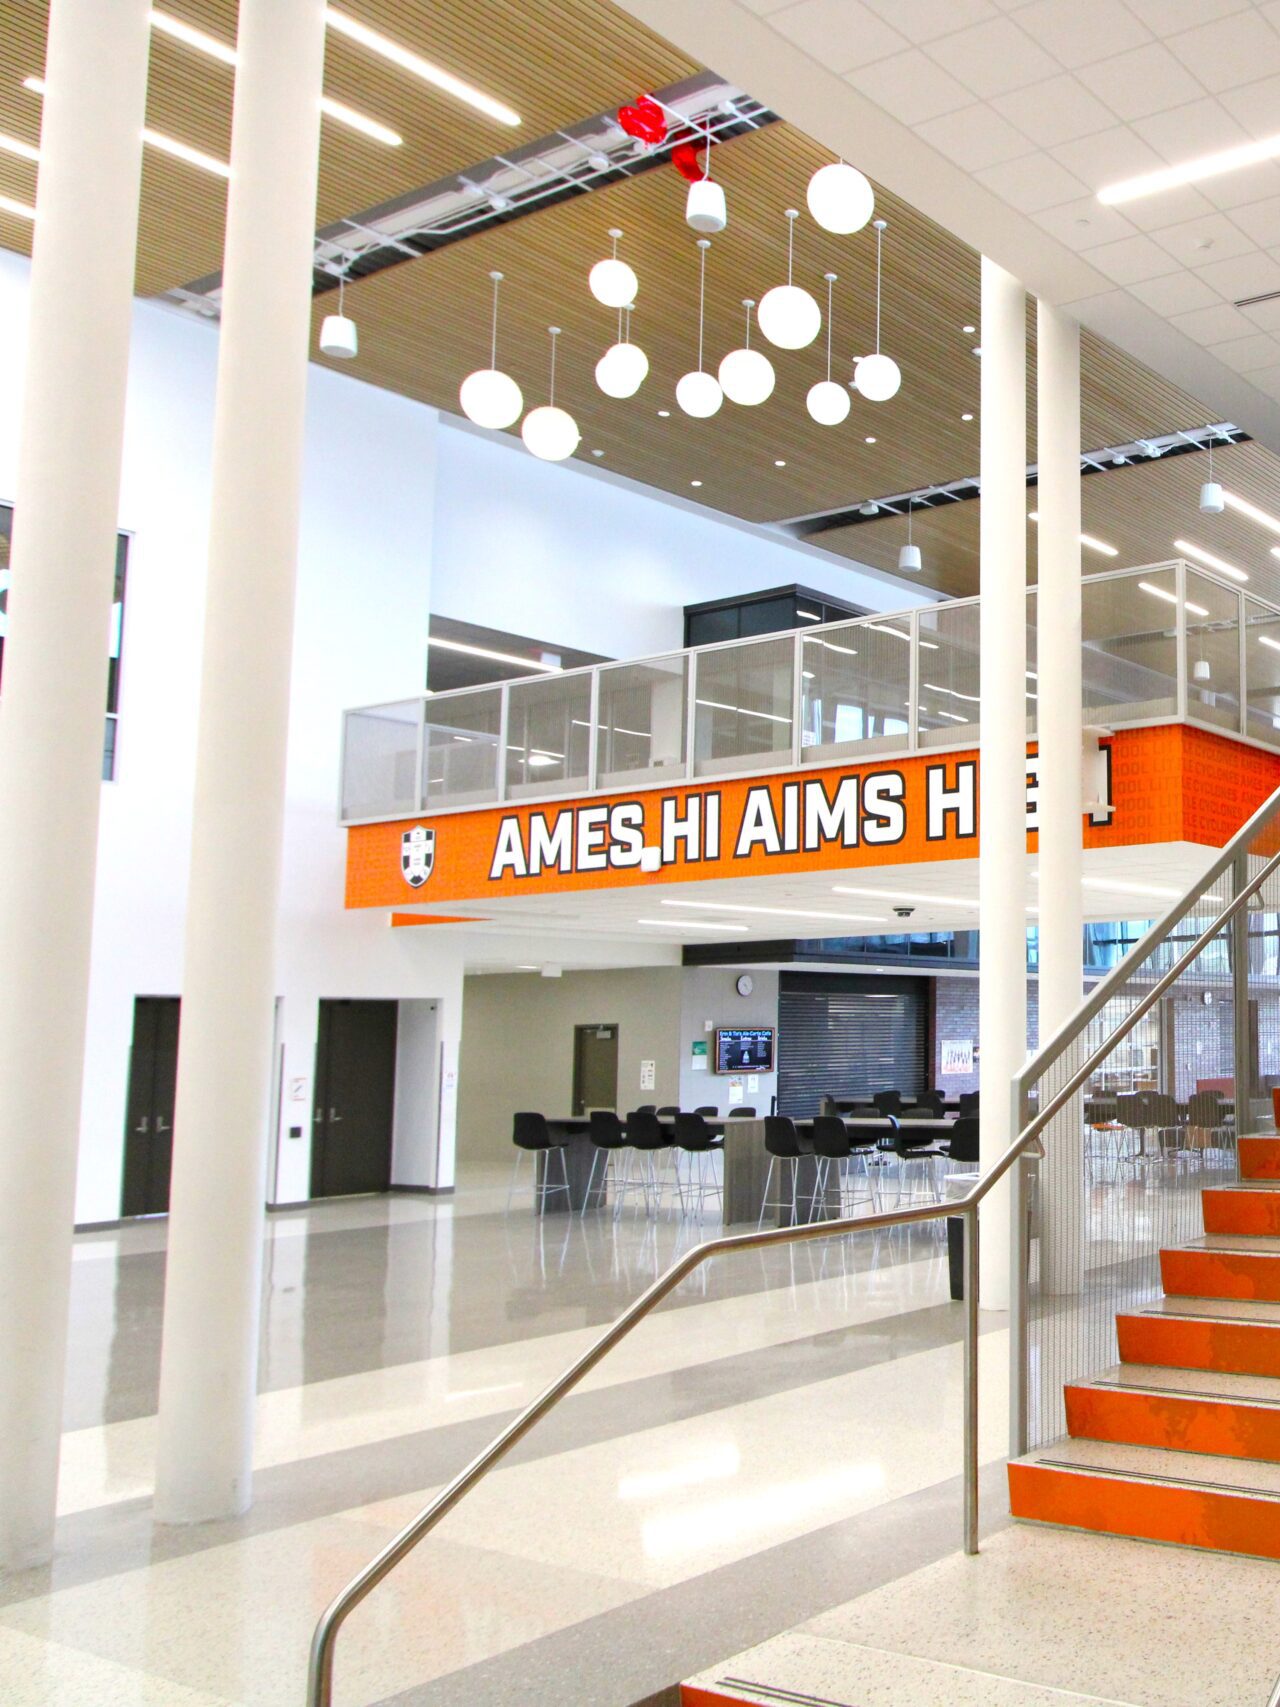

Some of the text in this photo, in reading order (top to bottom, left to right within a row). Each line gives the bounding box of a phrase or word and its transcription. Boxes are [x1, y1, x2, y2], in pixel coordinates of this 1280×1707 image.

[488, 801, 645, 881] AMES
[661, 790, 722, 865] HI
[733, 770, 907, 859] AIMS
